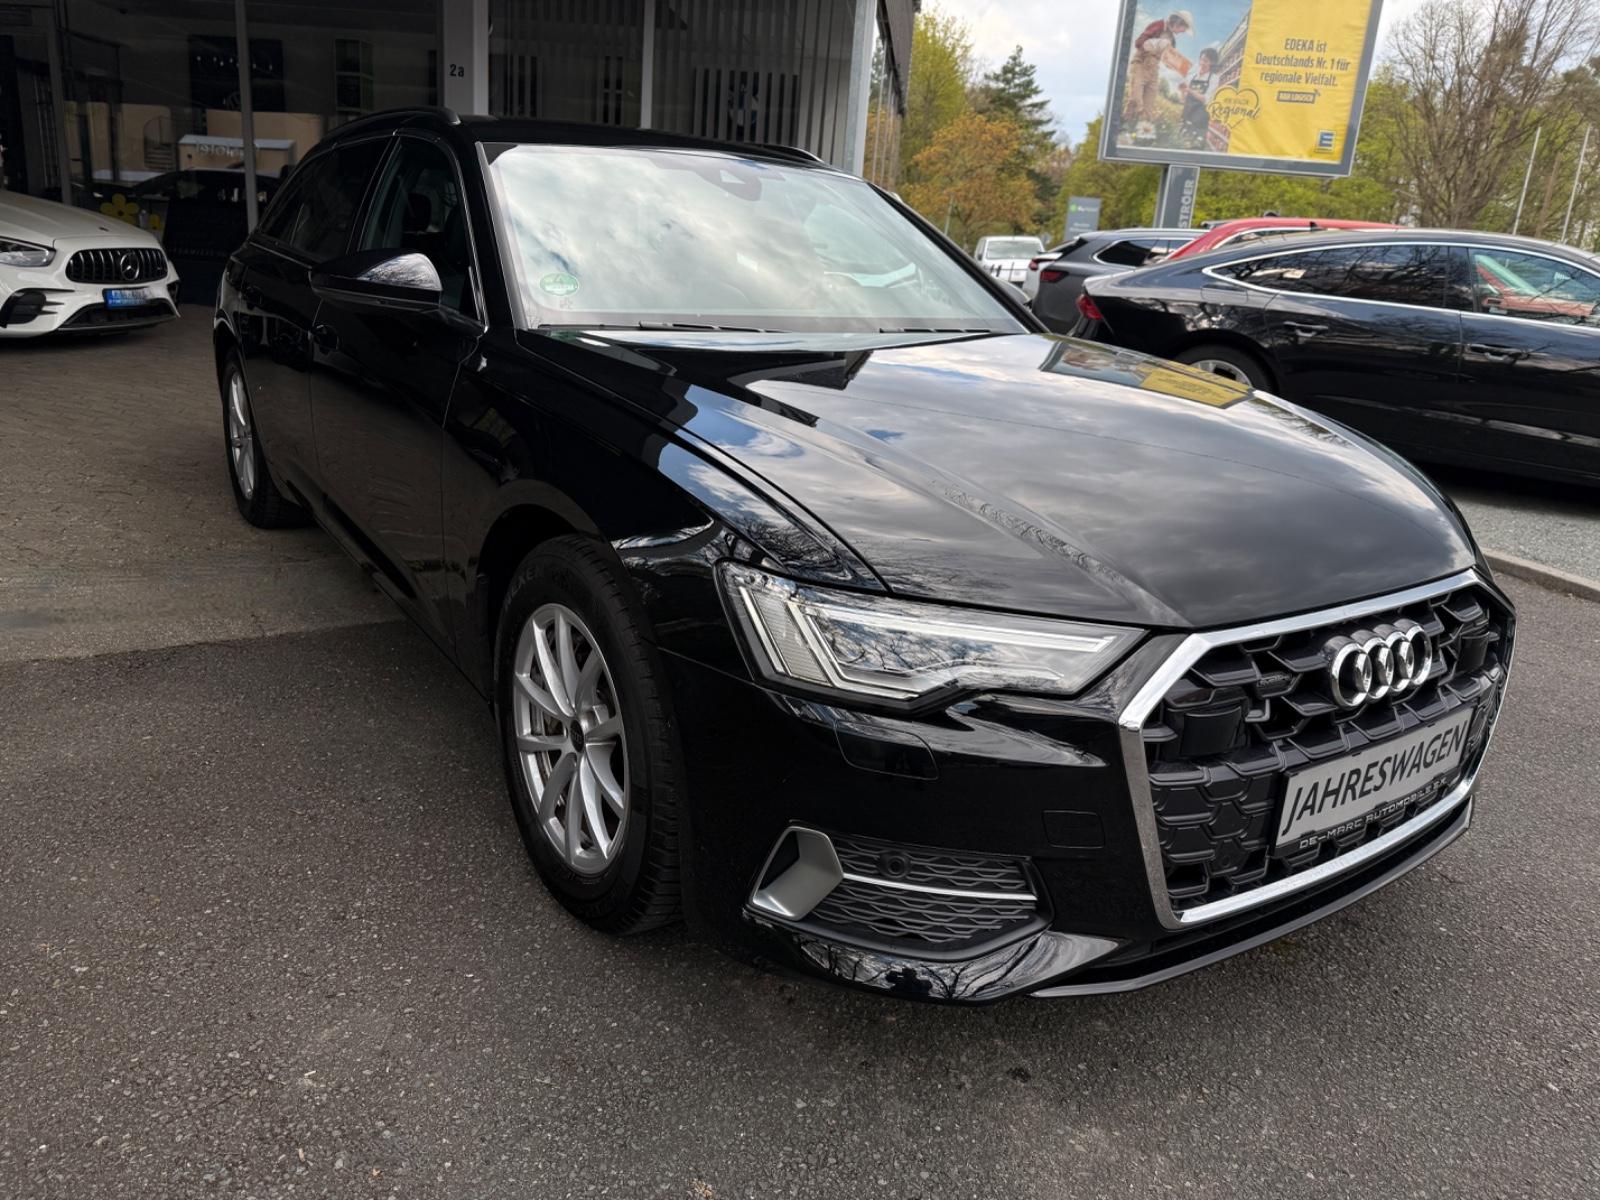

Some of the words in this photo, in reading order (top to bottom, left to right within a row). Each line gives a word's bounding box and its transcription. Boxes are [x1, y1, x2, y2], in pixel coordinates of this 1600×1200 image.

[1284, 38, 1314, 51] EDEKA
[1316, 40, 1328, 53] ist
[449, 63, 464, 77] 2a
[1255, 52, 1314, 68] Deutschlands
[1315, 56, 1328, 69] Nr.
[1336, 58, 1351, 71] für
[1260, 70, 1302, 85] regionale
[1304, 72, 1338, 86] Vielfalt.
[1282, 720, 1468, 836] JAHRESWAGEN
[1299, 817, 1366, 849] DE-MARC
